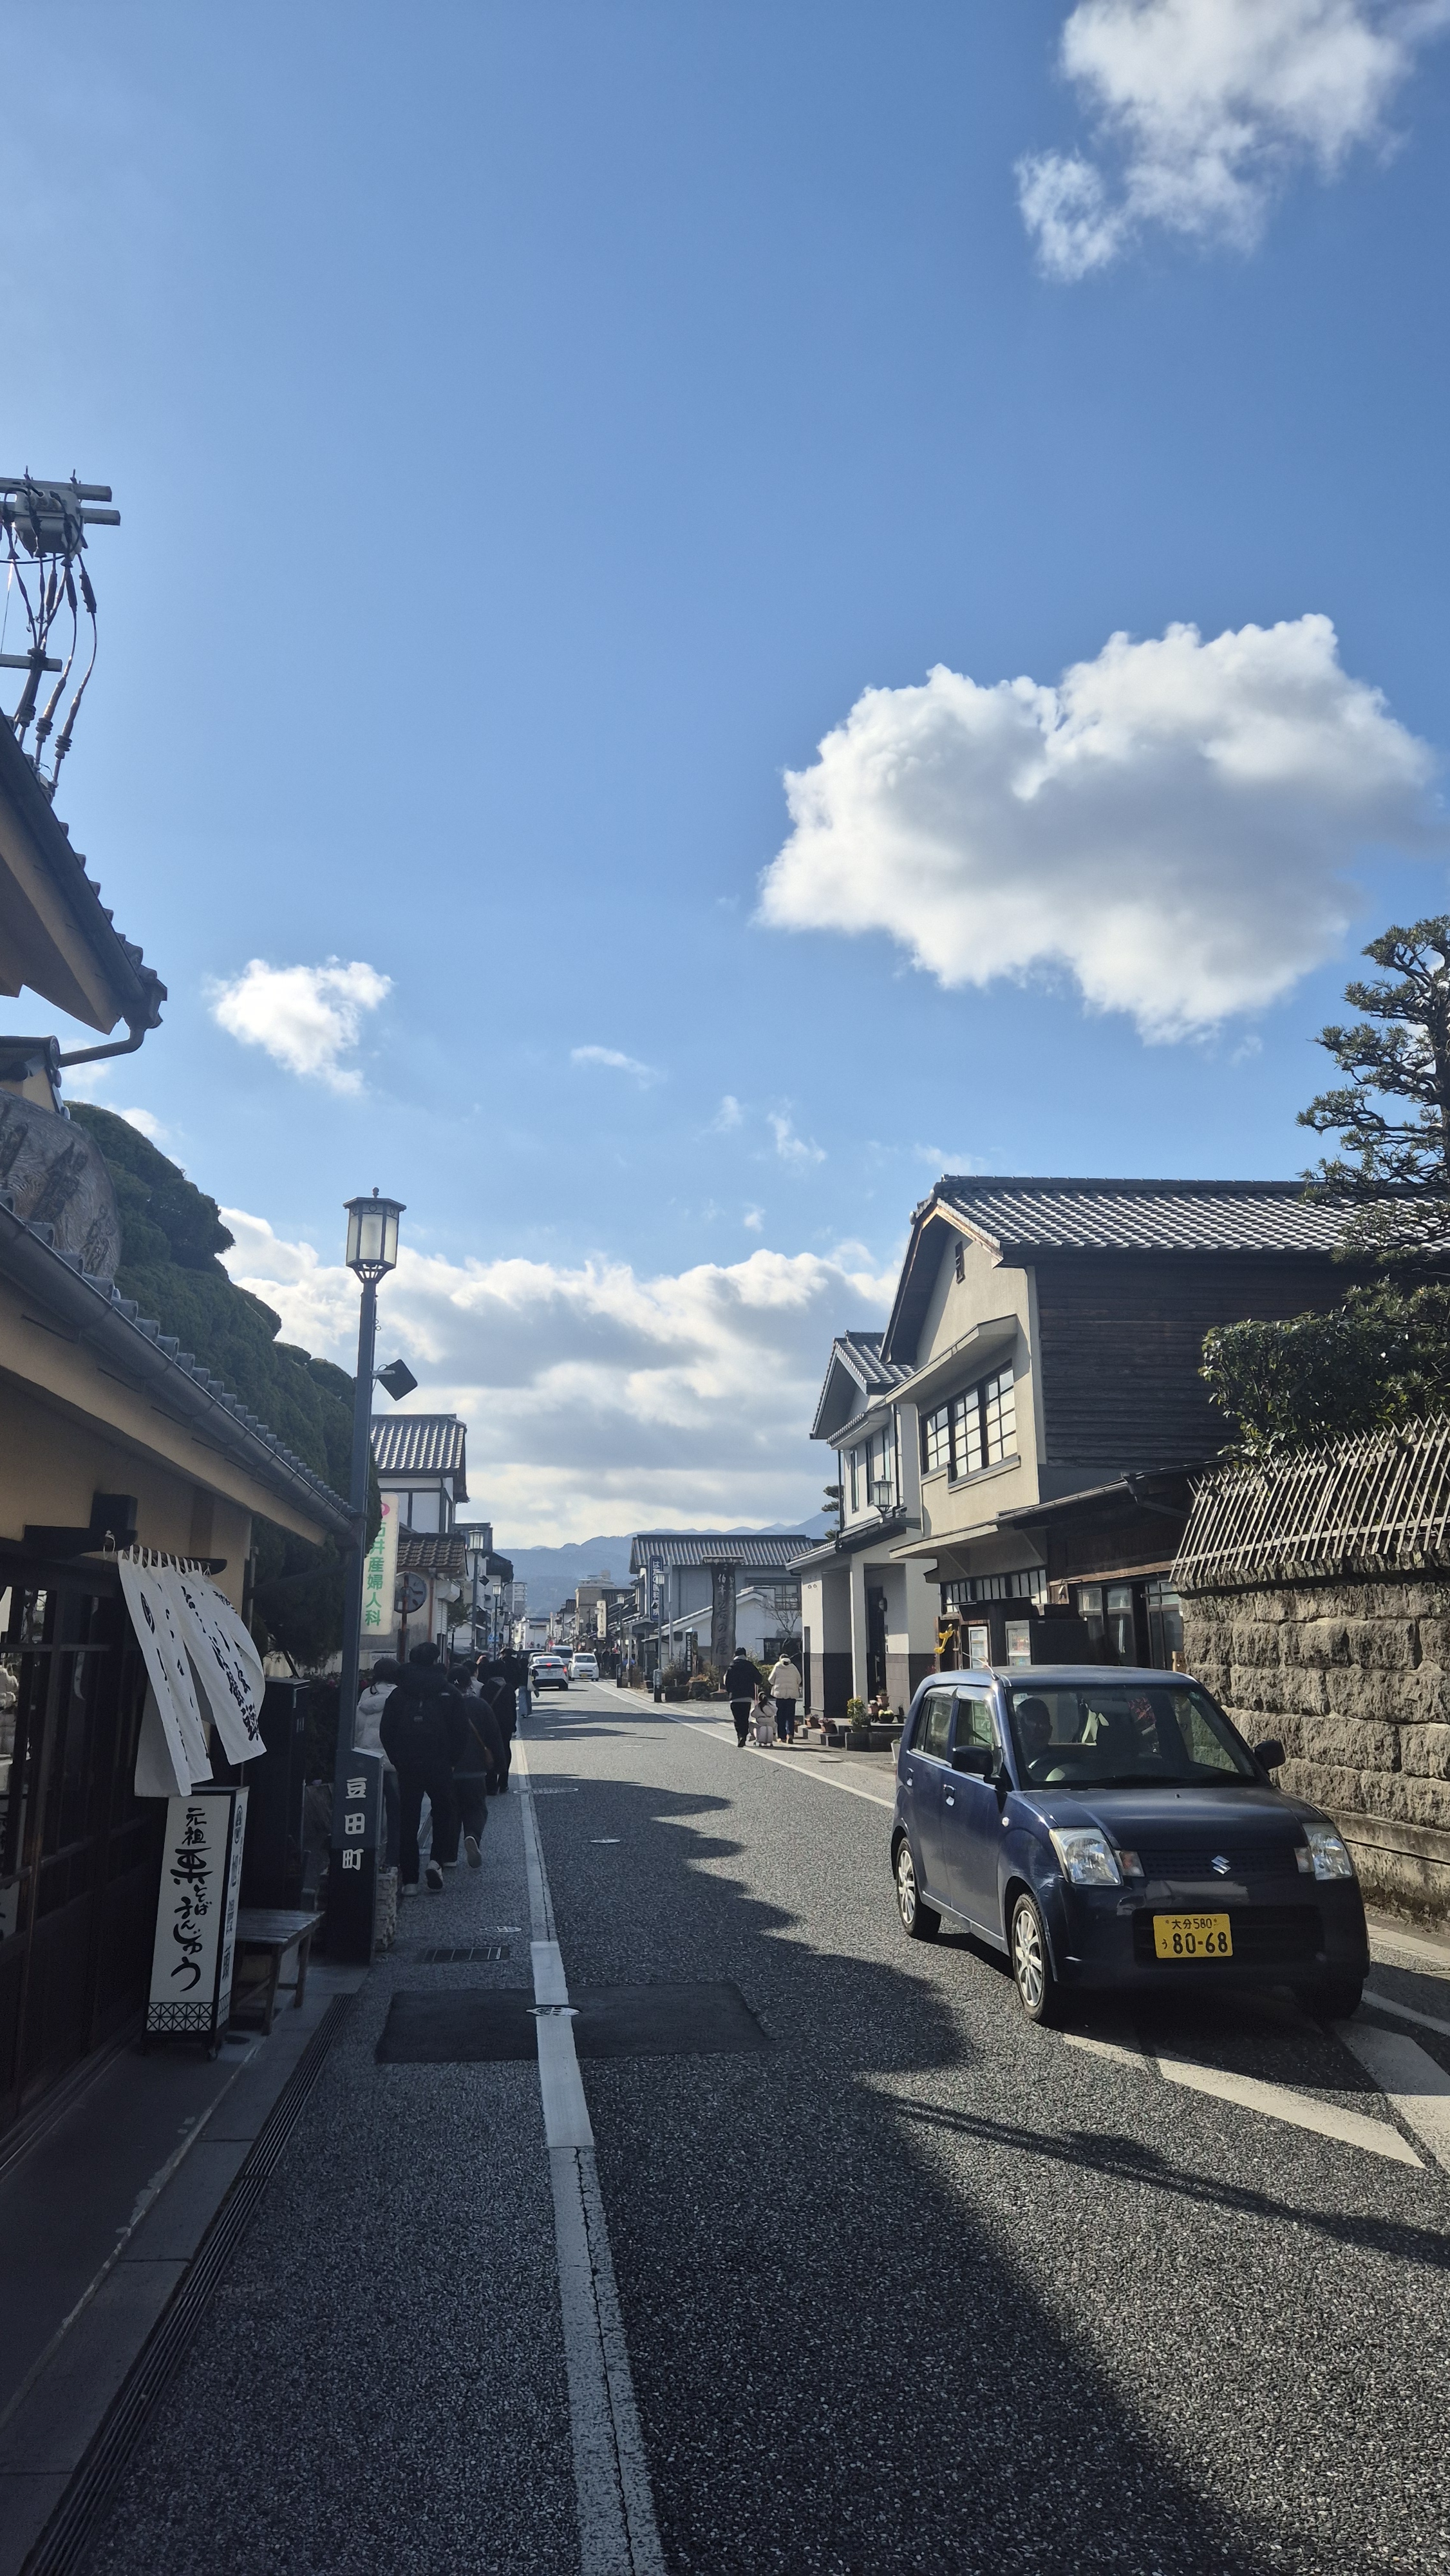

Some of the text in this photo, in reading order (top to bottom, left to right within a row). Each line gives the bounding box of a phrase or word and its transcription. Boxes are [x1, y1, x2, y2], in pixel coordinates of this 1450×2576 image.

[343, 1777, 368, 1871] 豆田町
[1172, 1931, 1228, 1955] 80-68
